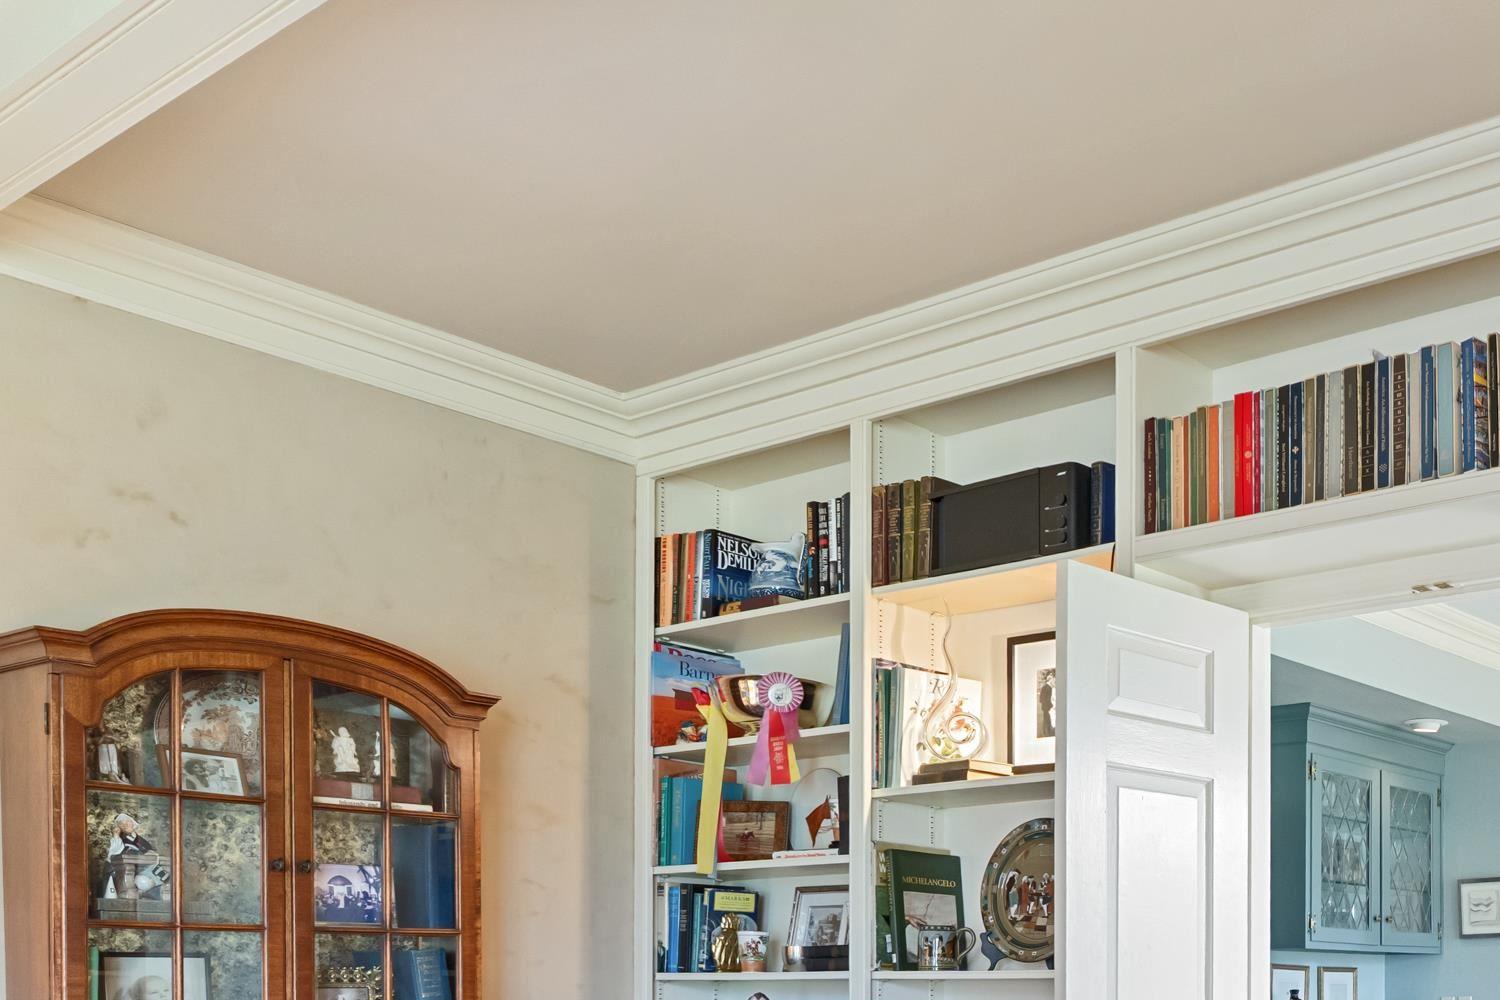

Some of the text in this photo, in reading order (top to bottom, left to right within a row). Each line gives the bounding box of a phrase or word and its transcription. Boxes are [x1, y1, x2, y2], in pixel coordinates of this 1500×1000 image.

[718, 536, 761, 559] NELSO
[717, 550, 758, 572] DEMIL
[717, 574, 748, 601] NIG
[680, 660, 717, 682] Barn
[902, 876, 956, 888] MICHELANGELO
